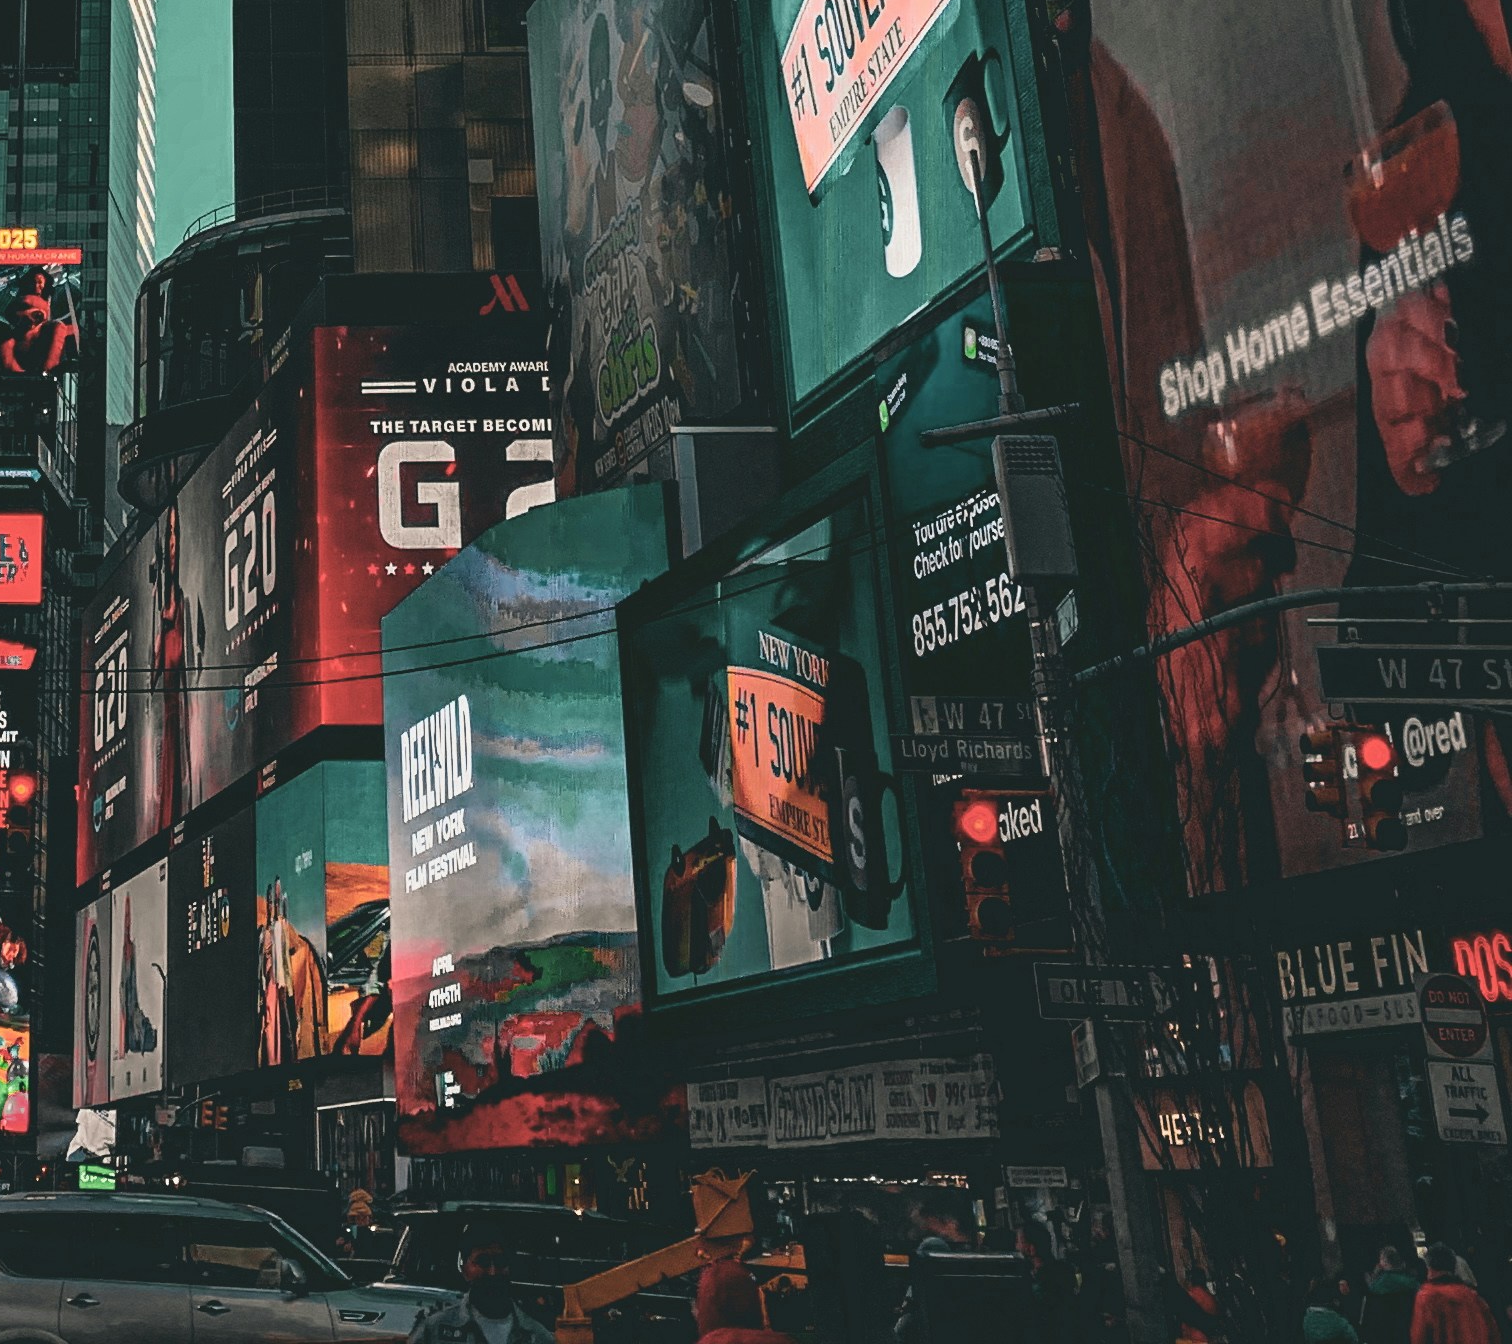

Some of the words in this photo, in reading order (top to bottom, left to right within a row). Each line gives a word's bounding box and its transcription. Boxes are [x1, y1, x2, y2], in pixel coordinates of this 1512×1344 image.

[791, 43, 818, 121] #1
[830, 70, 870, 144] EMPIRE
[868, 17, 905, 95] STATE
[9, 251, 42, 261] HUMAN
[44, 250, 76, 261] CRANE
[1159, 349, 1224, 420] Shop
[1227, 306, 1310, 385] Home
[1311, 211, 1477, 338] Essentials
[448, 362, 506, 373] ACADEMY
[422, 377, 520, 394] VIOLA
[370, 421, 405, 434] THE
[409, 420, 477, 434] TARGET
[224, 490, 277, 632] G20
[913, 553, 949, 580] Check
[758, 630, 790, 670] NEW
[1377, 657, 1407, 689] W
[1428, 658, 1463, 690] 47
[93, 645, 128, 753] G20
[735, 685, 761, 769] #1
[943, 702, 964, 730] W
[979, 702, 1004, 730] 47
[901, 739, 949, 763] Lloyd
[956, 739, 1033, 760] Richards
[1402, 711, 1468, 767] @red
[411, 824, 434, 857] NEW
[436, 807, 466, 845] YORK
[768, 793, 810, 838] EMPIRE
[1405, 809, 1422, 826] and
[1423, 805, 1445, 821] over
[405, 865, 427, 894] FILM
[428, 842, 477, 884] FESTIVAL
[432, 953, 455, 978] APRIL
[1277, 941, 1359, 1001] BLUE
[1370, 929, 1429, 989] FIN
[1427, 990, 1444, 1004] DO
[1448, 992, 1470, 1004] NOT
[1438, 1027, 1477, 1042] ENTER
[1450, 1066, 1476, 1083] ALL
[825, 1073, 875, 1135] SLAM
[1442, 1083, 1488, 1100] TRAFFIC
